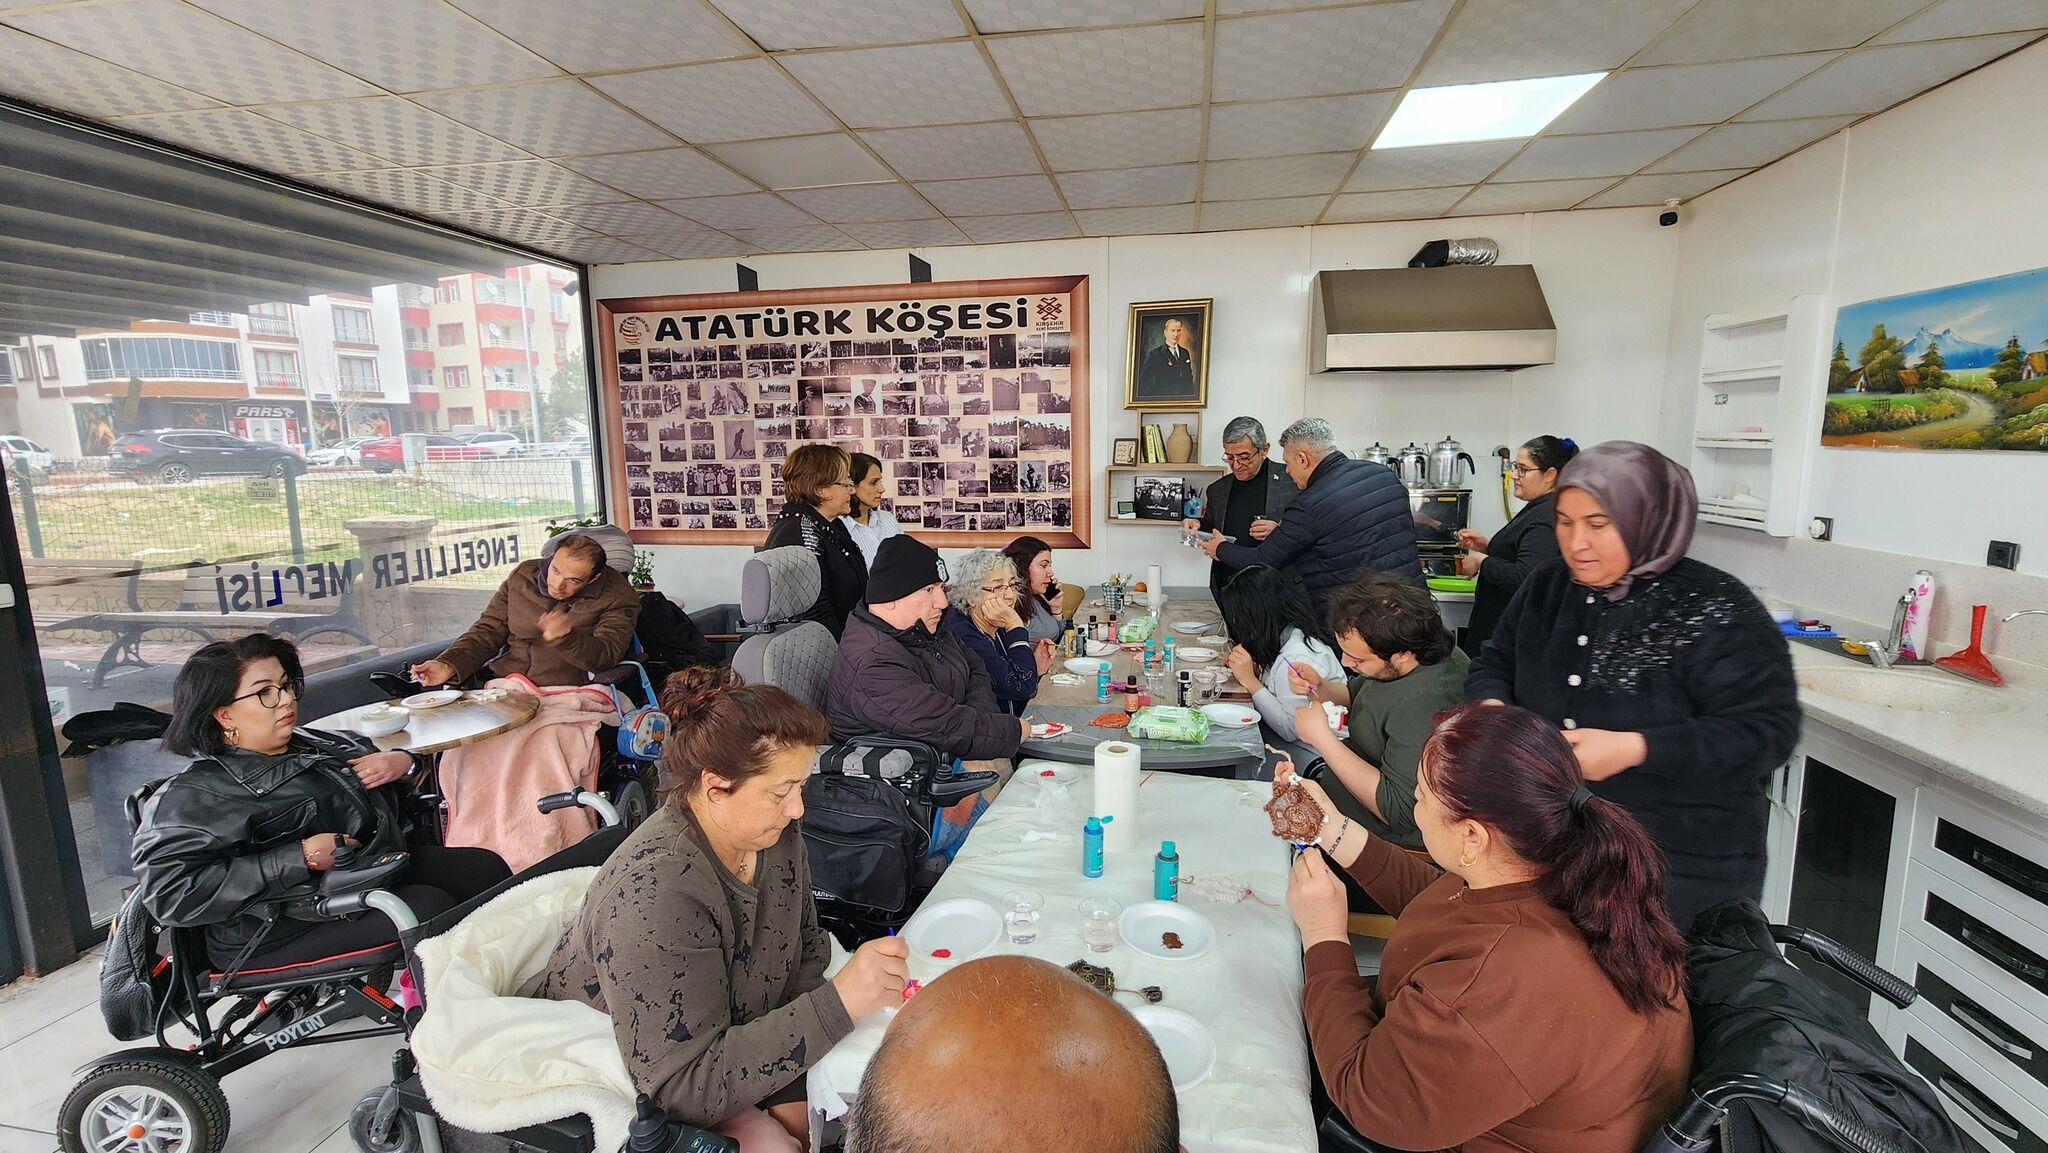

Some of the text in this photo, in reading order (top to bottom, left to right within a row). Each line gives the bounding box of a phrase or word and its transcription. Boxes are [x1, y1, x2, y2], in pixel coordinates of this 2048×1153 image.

[655, 307, 853, 342] ATATÜRK
[866, 297, 1028, 339] KÖŞESİ
[236, 406, 284, 417] PARS
